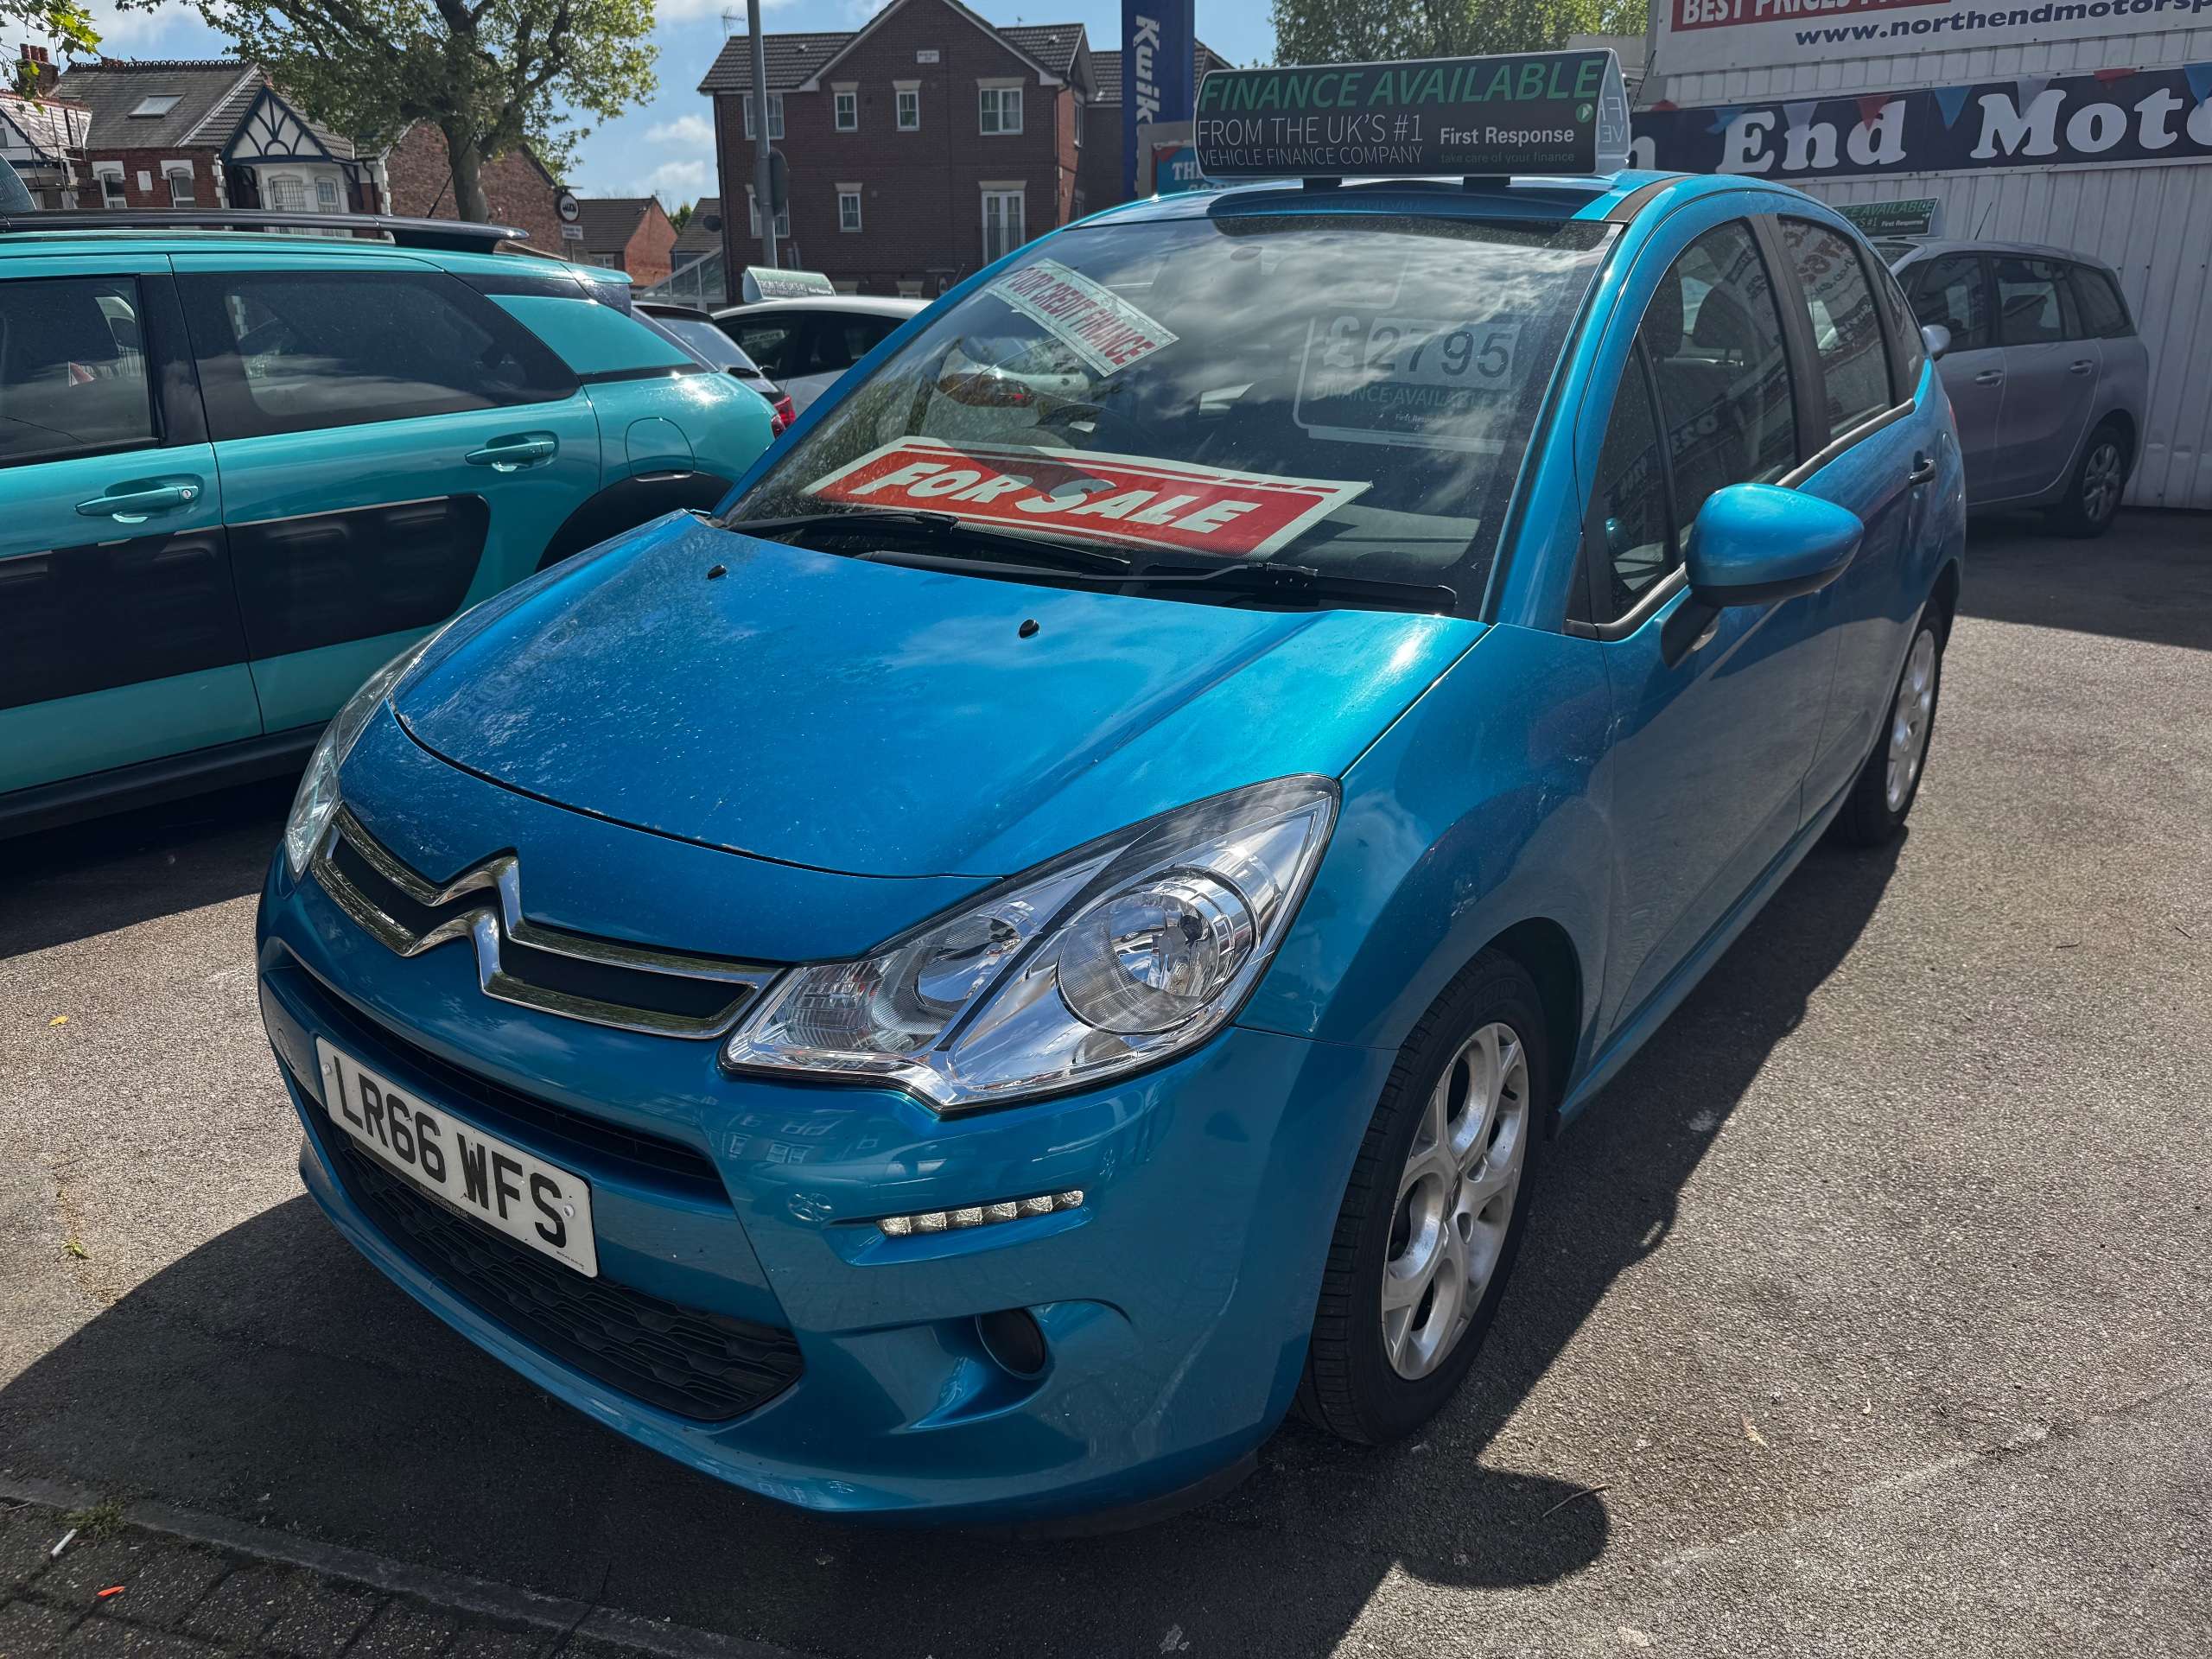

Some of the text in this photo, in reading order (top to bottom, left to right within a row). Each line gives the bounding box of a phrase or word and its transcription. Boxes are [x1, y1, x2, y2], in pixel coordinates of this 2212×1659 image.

[1756, 0, 1851, 16] PRI
[1133, 15, 1160, 125] Kwik
[1199, 59, 1605, 111] FINANCE AVAILABLE
[1198, 113, 1423, 146] FROM THE UK'S #1
[1198, 145, 1423, 166] VEHICLE FINANCE COMPANY
[1440, 126, 1574, 147] First Response
[1716, 99, 1907, 174] End
[1465, 154, 1488, 163] care
[1491, 152, 1503, 162] of
[1861, 200, 1936, 215] AVAILABLE
[1029, 282, 1099, 328] CREDIT
[1074, 307, 1156, 365] FINANCE
[1323, 315, 1512, 378] £2795
[848, 461, 1264, 535] FOR SALE
[334, 1055, 567, 1249] LR66 WFS
